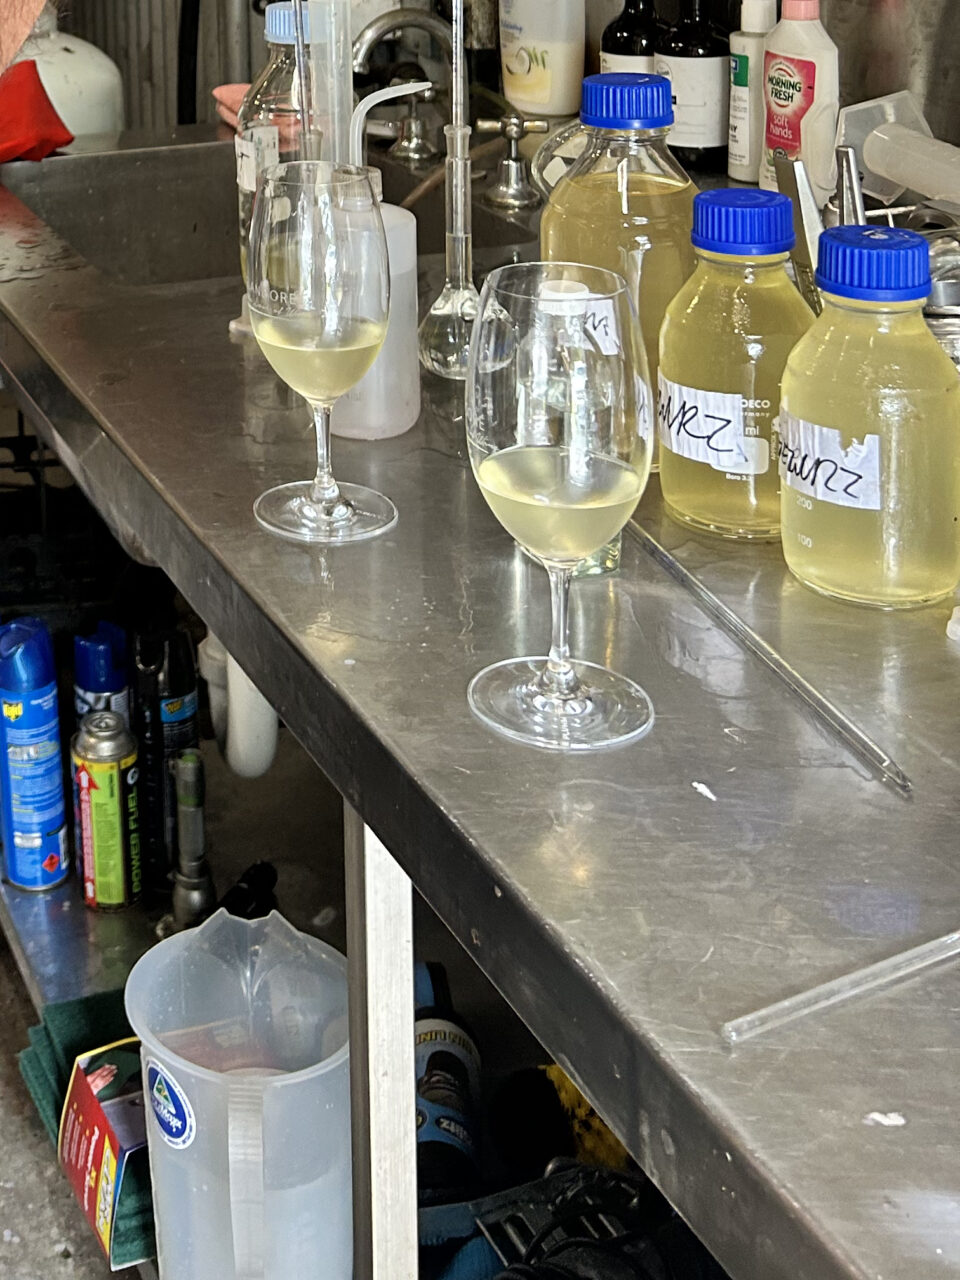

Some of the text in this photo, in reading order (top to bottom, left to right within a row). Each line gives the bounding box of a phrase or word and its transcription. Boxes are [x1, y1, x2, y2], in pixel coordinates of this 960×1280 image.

[768, 75, 801, 93] MORNING
[771, 87, 794, 103] FRESH
[773, 114, 789, 125] soft
[770, 124, 792, 139] hands
[745, 425, 759, 435] ml
[796, 497, 813, 511] 200
[796, 534, 813, 549] 100
[127, 785, 140, 831] FUEL
